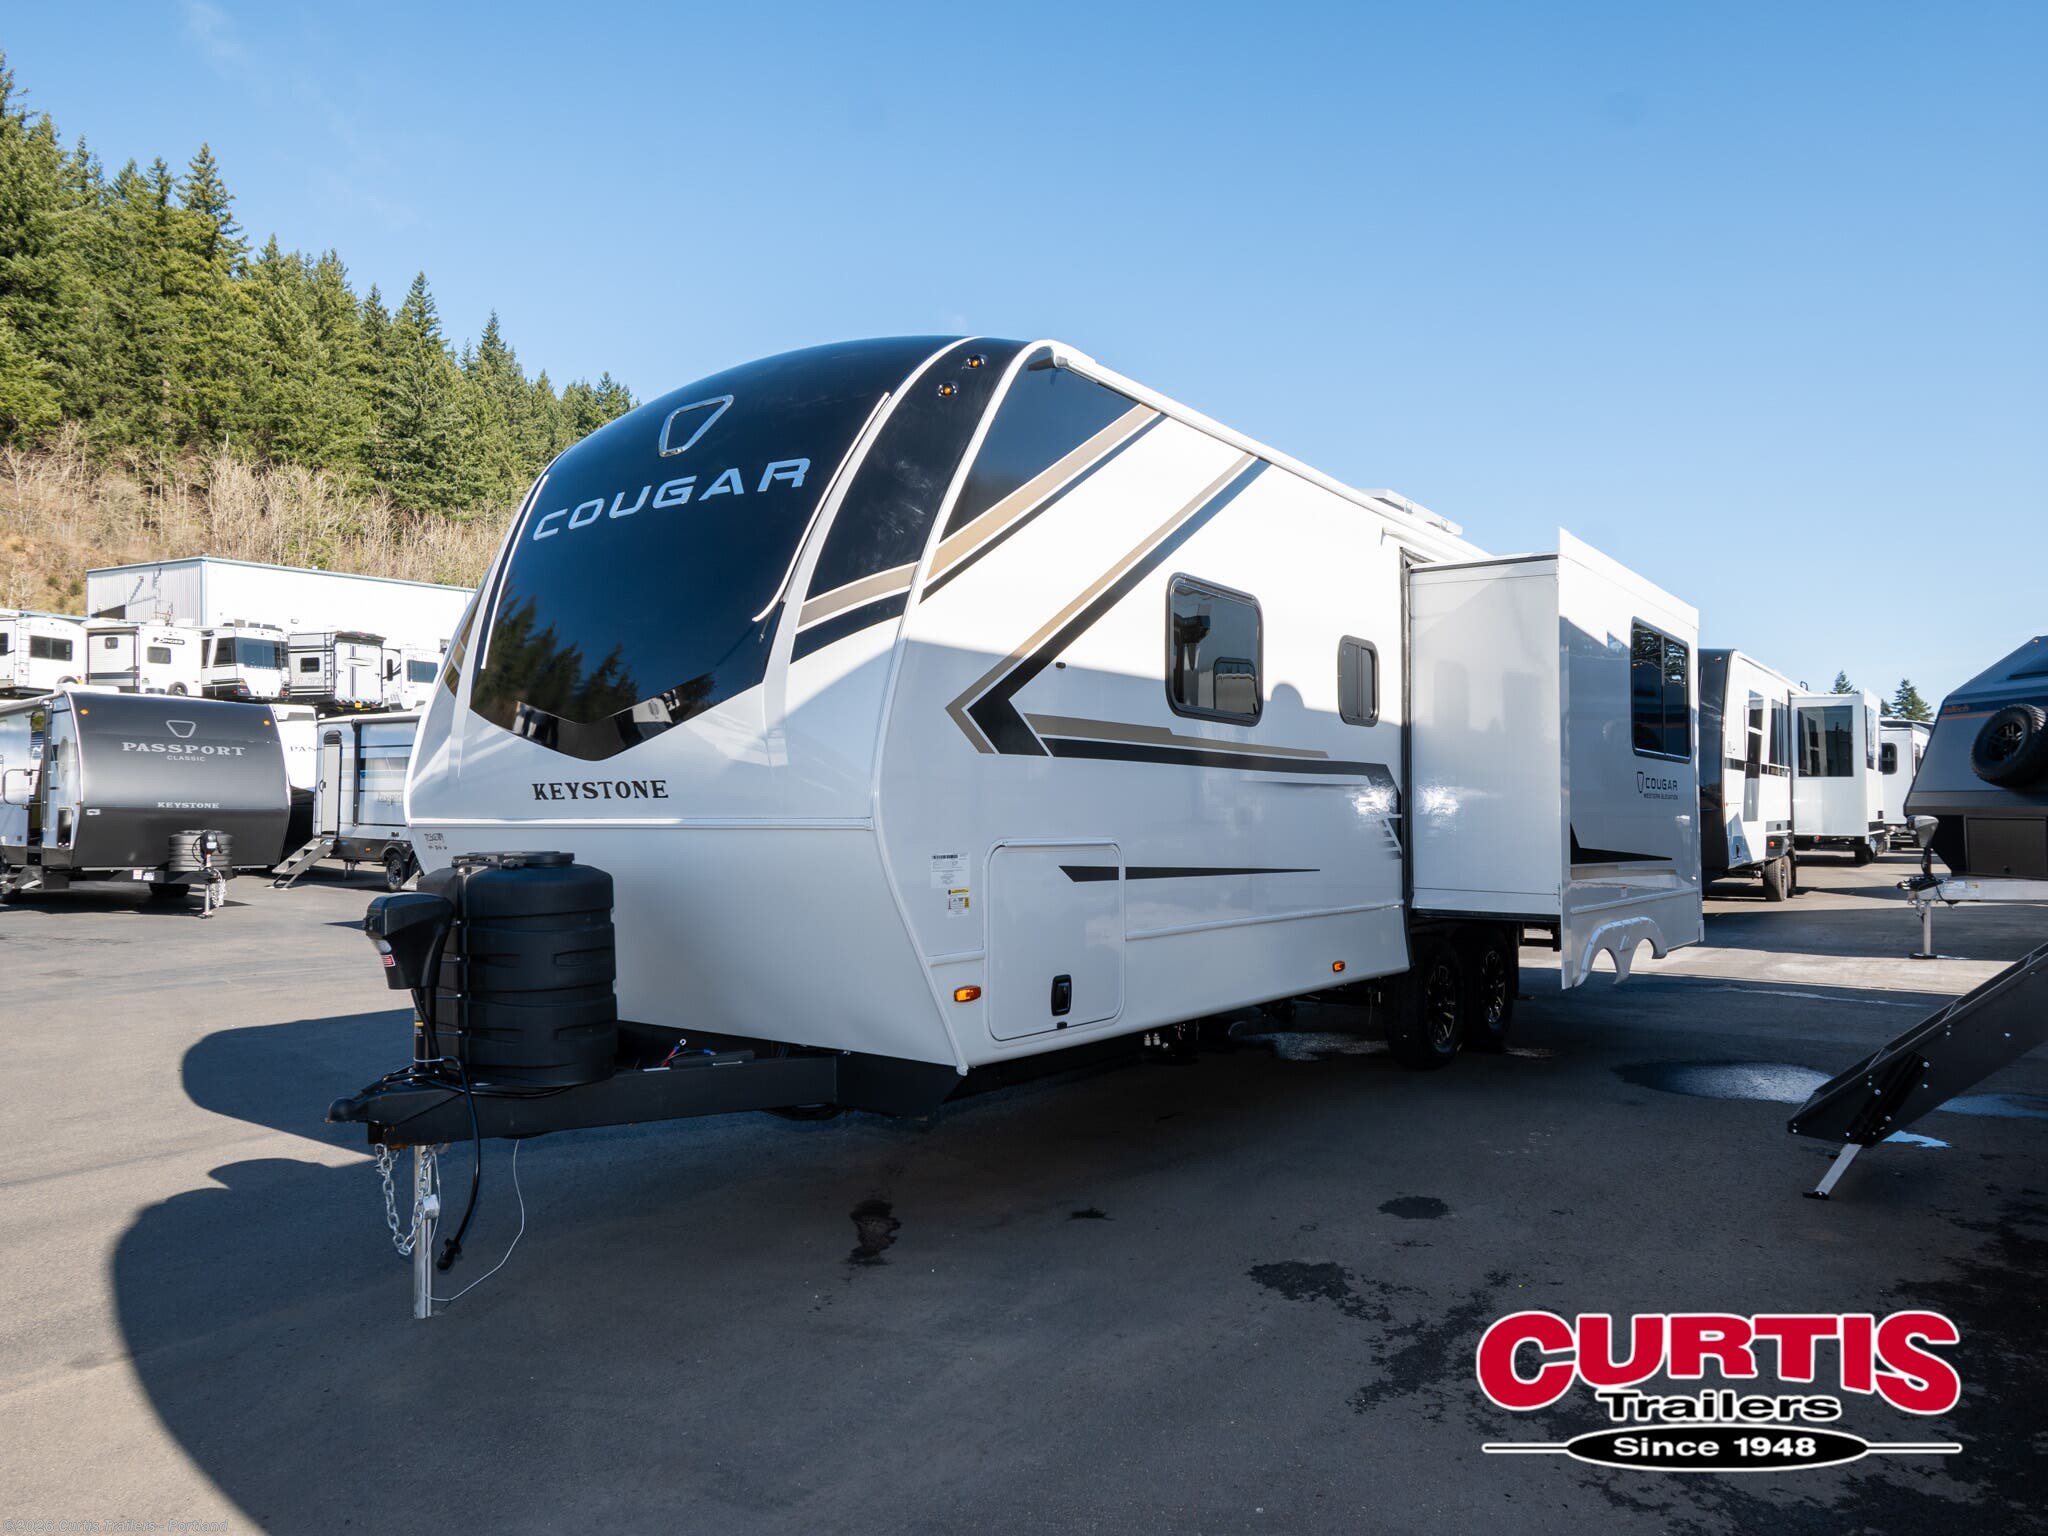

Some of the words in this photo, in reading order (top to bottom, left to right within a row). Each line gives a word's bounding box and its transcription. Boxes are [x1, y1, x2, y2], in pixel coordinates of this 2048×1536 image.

[533, 457, 811, 541] COUGAR
[121, 742, 246, 756] PASSPORT
[532, 779, 669, 801] KEYSTONE
[1646, 777, 1678, 791] COUGAR
[157, 801, 220, 809] KEYSTONE
